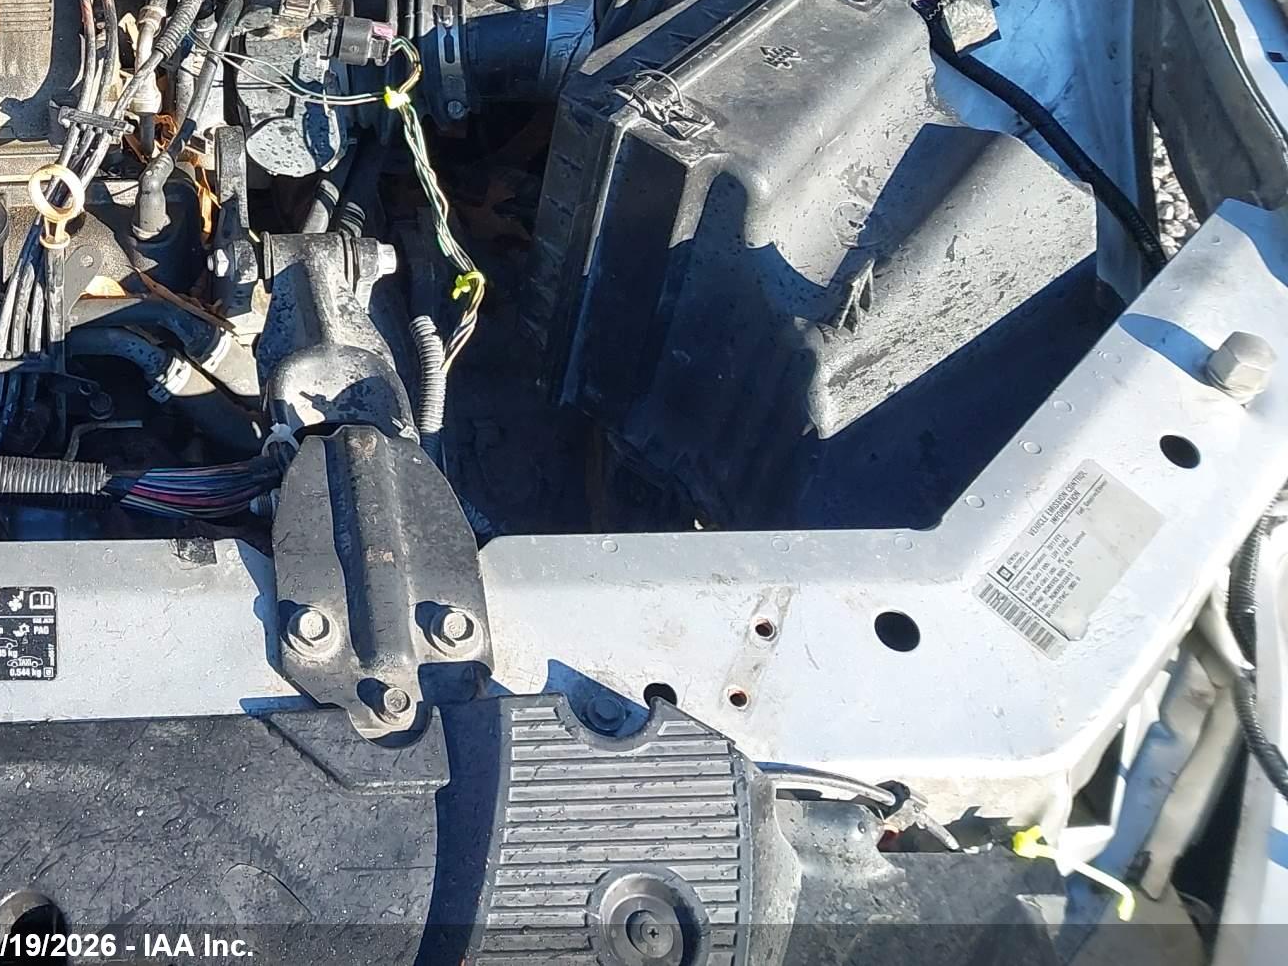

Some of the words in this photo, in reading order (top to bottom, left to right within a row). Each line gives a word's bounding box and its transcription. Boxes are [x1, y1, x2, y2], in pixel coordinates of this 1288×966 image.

[1027, 513, 1048, 537] VEHICLE
[1044, 490, 1068, 516] EMISSION
[1064, 468, 1087, 493] CONTROL
[1049, 489, 1080, 524] INFORMATION
[8, 649, 18, 659] kg
[18, 658, 32, 666] TAXI
[9, 667, 30, 677] 0.544
[31, 668, 42, 678] kg
